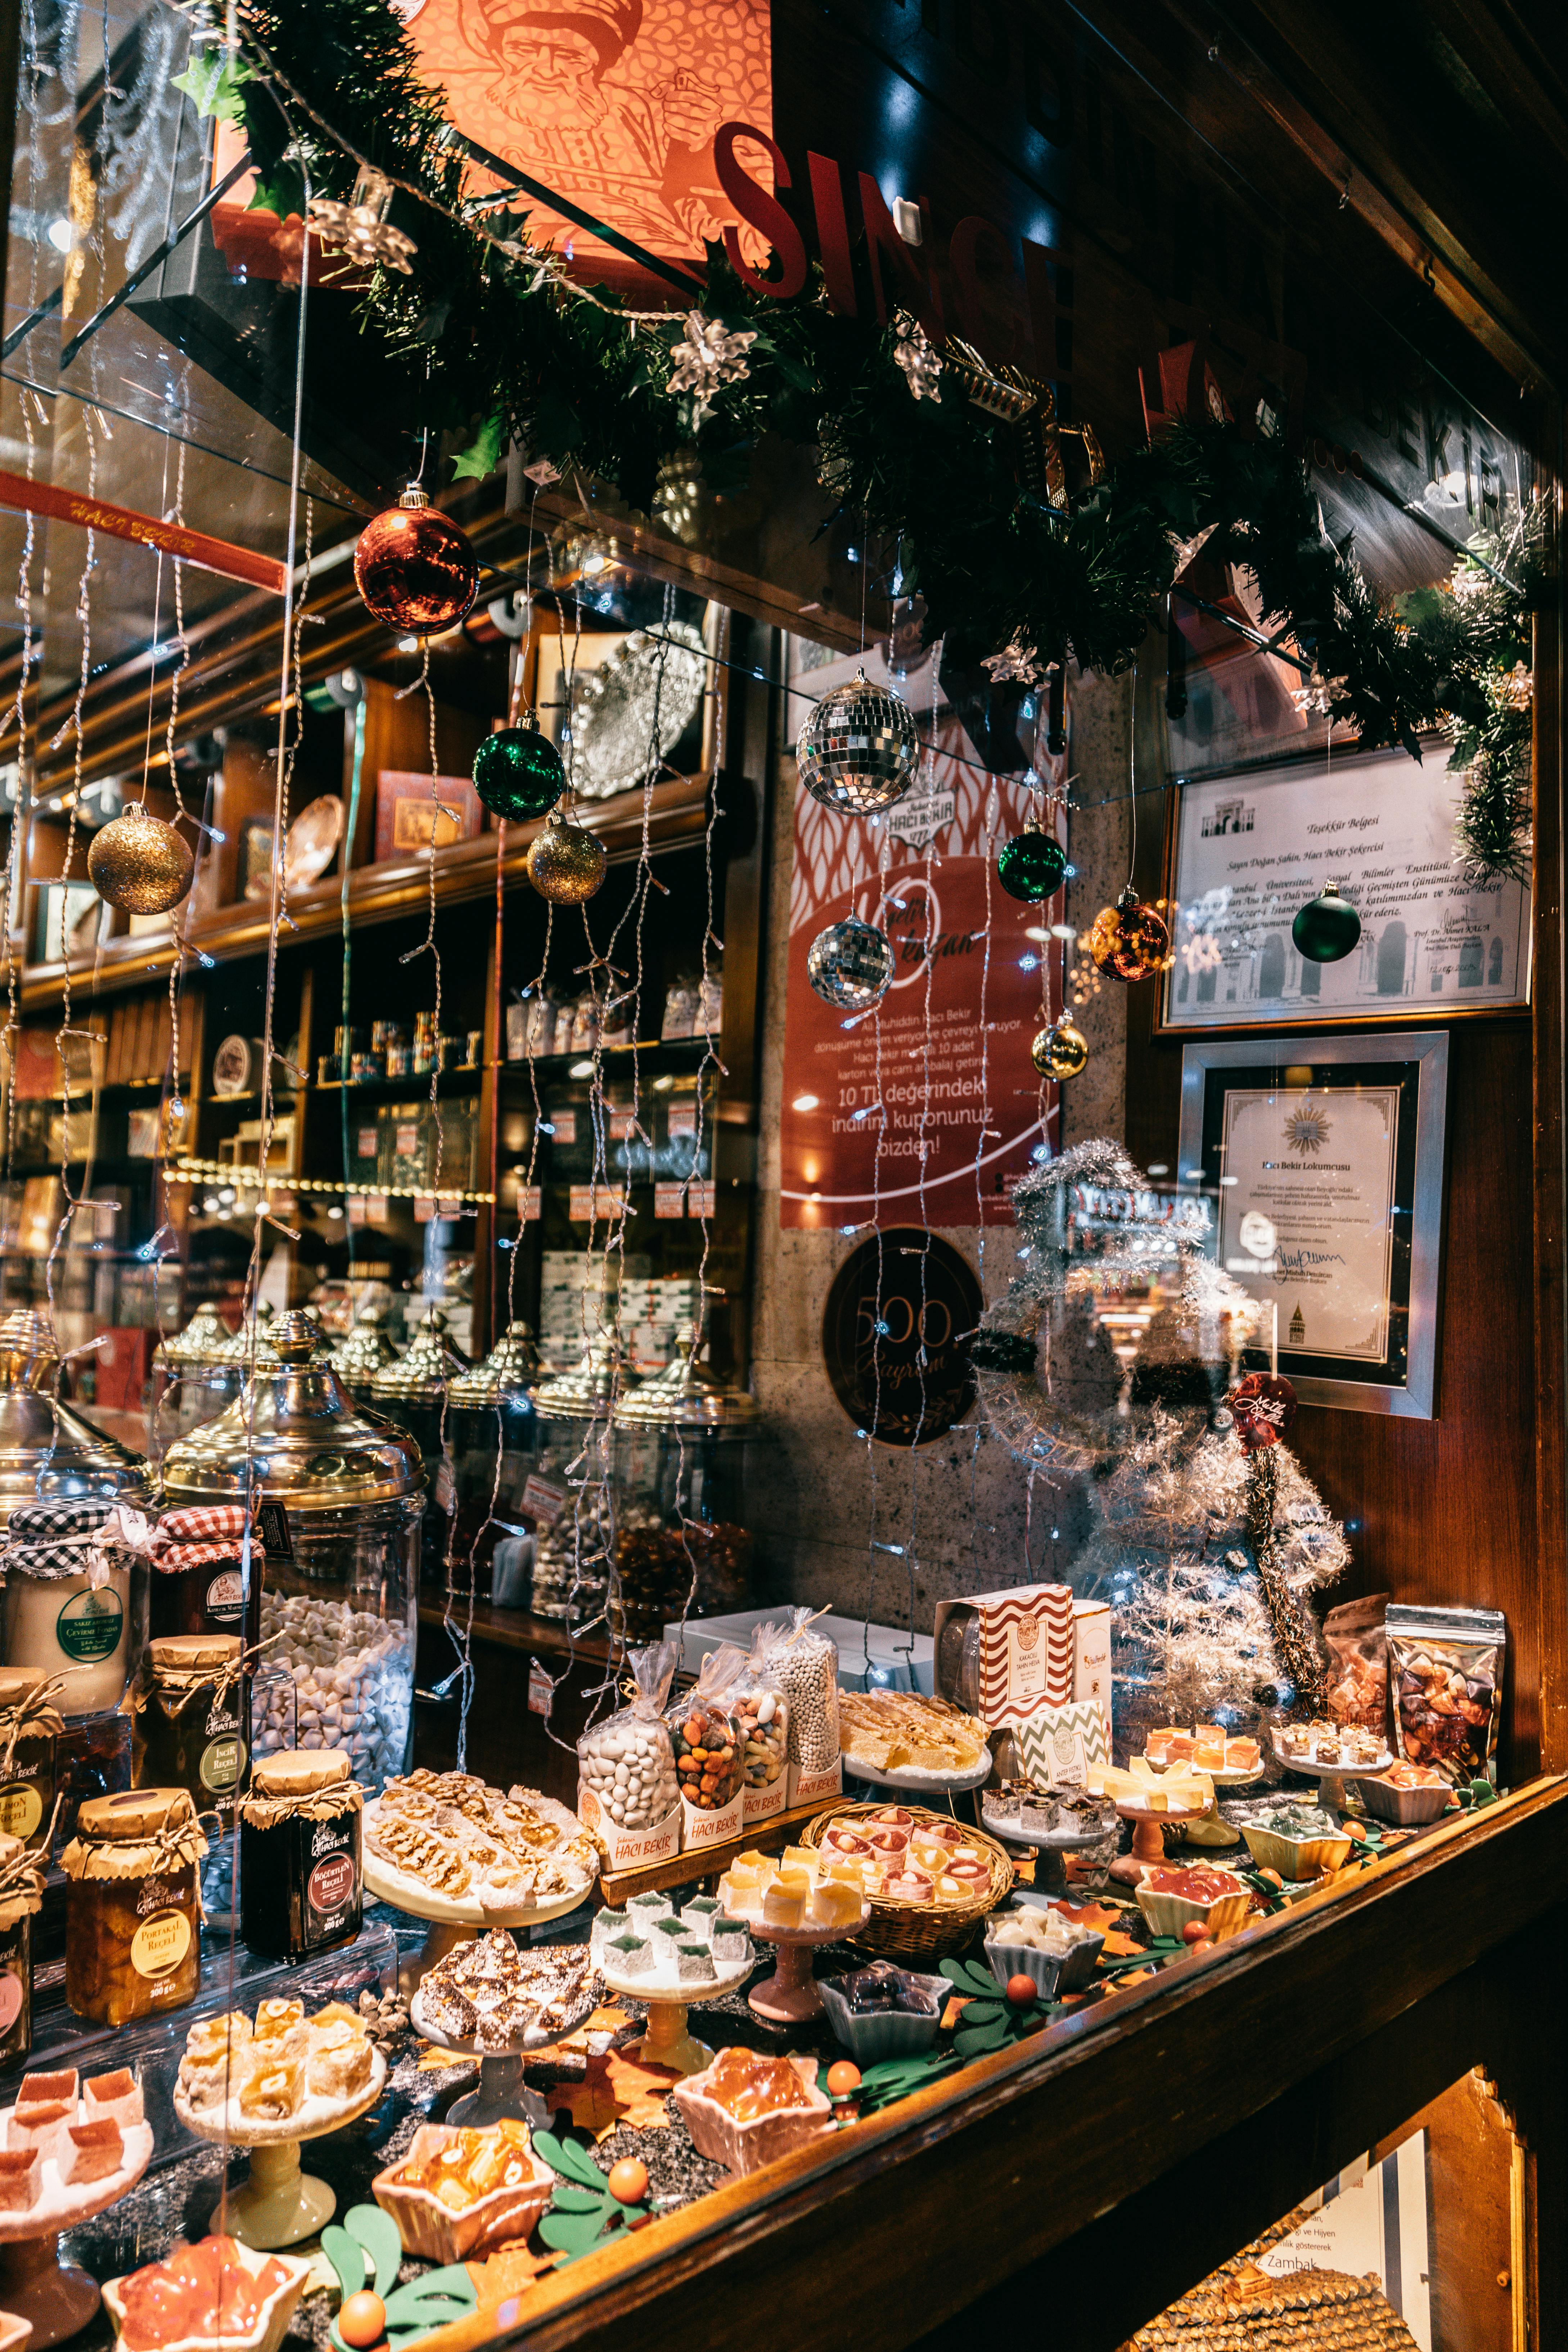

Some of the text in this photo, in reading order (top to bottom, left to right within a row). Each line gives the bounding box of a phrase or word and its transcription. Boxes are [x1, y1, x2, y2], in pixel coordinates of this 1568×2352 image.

[1307, 814, 1380, 834] Teşekkür Belgesi
[1324, 846, 1347, 859] Bekir
[1347, 841, 1385, 858] Şekercisi
[1361, 866, 1395, 880] Bilimler
[1405, 860, 1450, 874] Enstitüsü,
[1367, 880, 1409, 894] Geçmişten
[1412, 875, 1460, 889] Günümüze
[1365, 889, 1428, 907] katılımınızdan
[1433, 889, 1443, 898] ve
[1374, 907, 1401, 917] ederiz.
[939, 1042, 951, 1054] 10
[952, 1040, 974, 1053] adet
[839, 1086, 857, 1108] 10
[893, 1107, 994, 1132] kuponunuz
[878, 1135, 941, 1157] bizden!
[1281, 1161, 1351, 1171] Bekir Lokumcusu
[1019, 1652, 1038, 1662] KAKAOLU
[1056, 1768, 1068, 1779] ANTEP
[796, 1772, 837, 1796] HACI BEKİR
[761, 1789, 781, 1811] BEKİR
[691, 1812, 738, 1839] HACI BEKİR
[321, 1841, 334, 1853] HACI
[616, 1833, 671, 1860] HACI BEKİR
[322, 1872, 344, 1890] REÇELİ
[149, 1888, 185, 1910] HACI BEKİR
[141, 1920, 183, 1942] PORTAKAL
[1314, 2229, 1335, 2239] Hijyen
[1296, 2242, 1332, 2251] göstererek
[1268, 2255, 1317, 2271] Zambak
